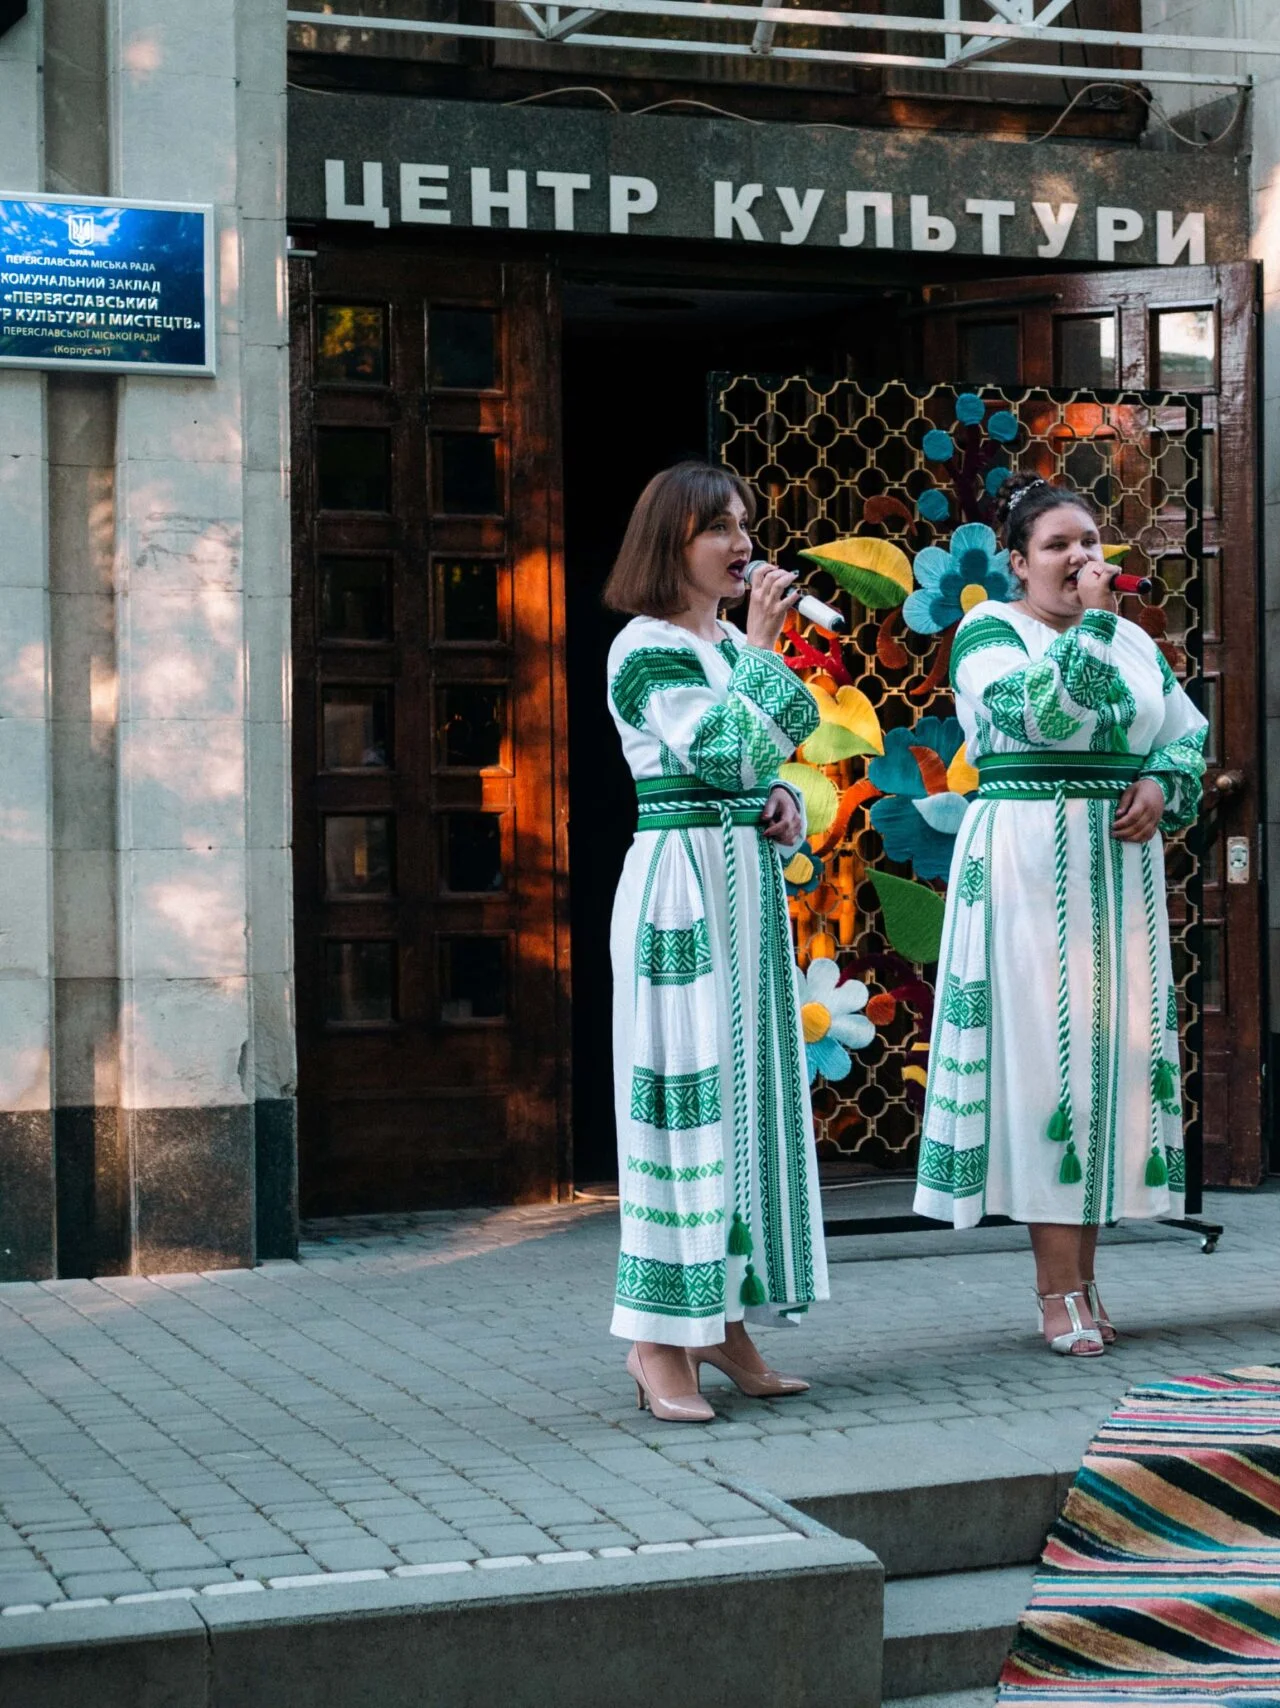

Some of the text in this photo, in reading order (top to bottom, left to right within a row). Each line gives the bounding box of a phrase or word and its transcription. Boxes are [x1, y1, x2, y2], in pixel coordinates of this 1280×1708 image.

[324, 159, 1206, 266] ЦЕНТР КУЛЬТУРИ
[5, 254, 156, 272] ПЕРЕЯСЛАВСЬКА МІСЬКА РАДА
[0, 272, 161, 294] КОМУНАЛЬНИЙ ЗАКЛАД
[3, 290, 159, 311] «ПЕРЕЯСЛАВСЬКИЙ
[15, 308, 97, 325] КУЛЬТУРИ
[108, 312, 201, 331] МИСТЕЦТВ»
[3, 326, 90, 339] ПЕРЕЯСЛАВСЬКОЇ
[133, 332, 161, 343] РАДИ
[53, 344, 94, 357] (Корпус
